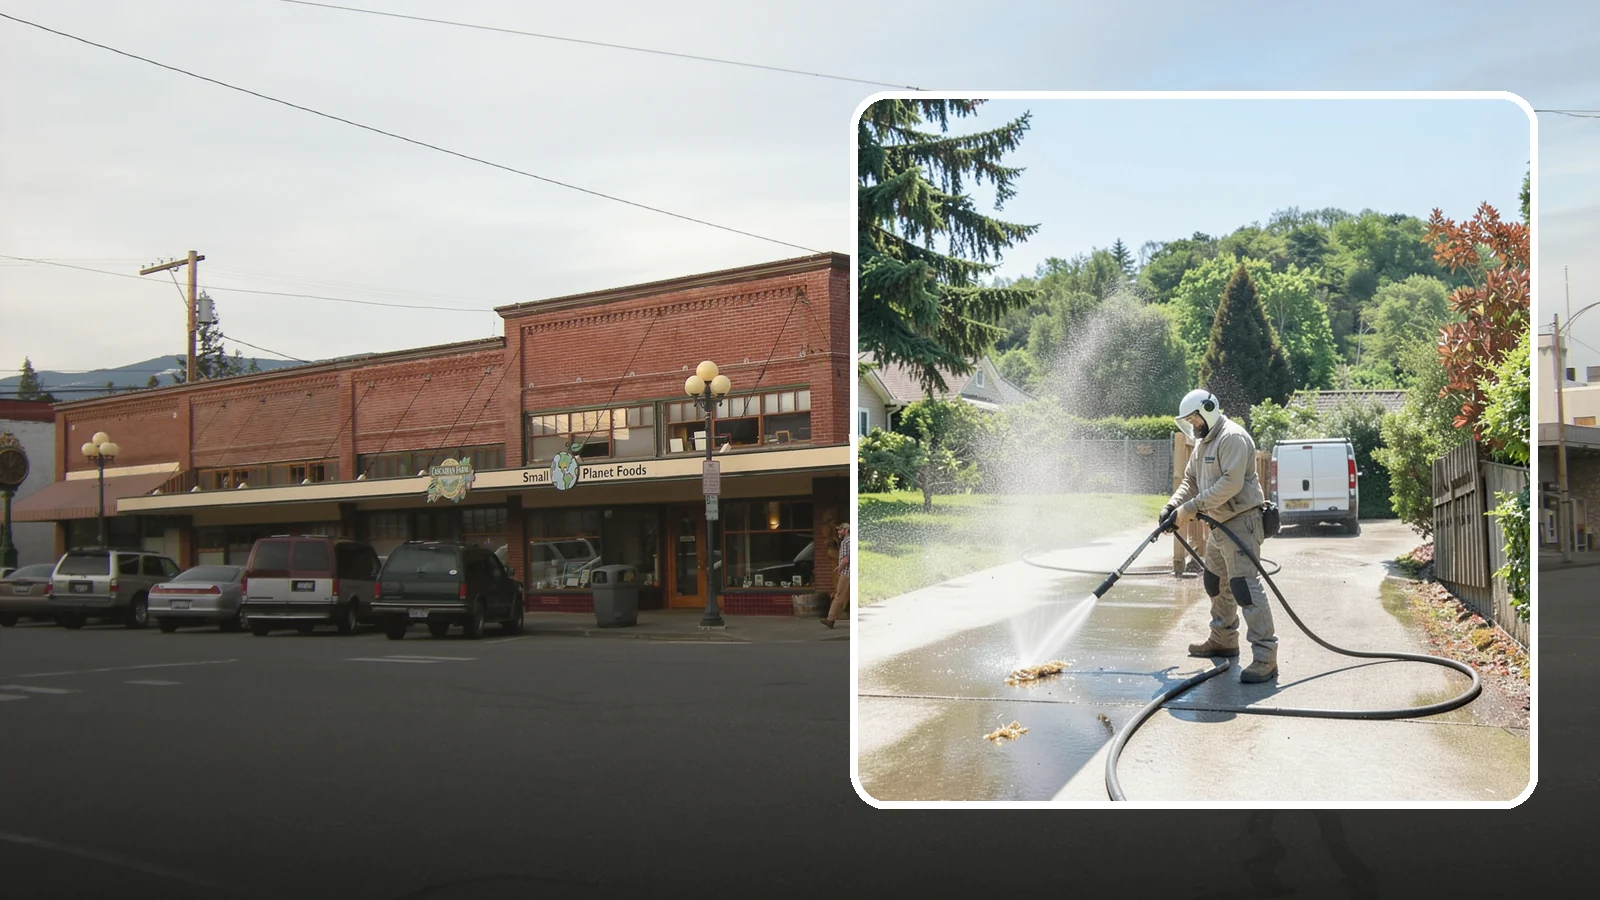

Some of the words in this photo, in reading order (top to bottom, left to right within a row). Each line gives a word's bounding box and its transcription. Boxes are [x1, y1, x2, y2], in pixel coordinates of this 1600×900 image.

[523, 471, 549, 483] Small
[582, 467, 614, 479] Planet
[617, 464, 647, 477] Foods
